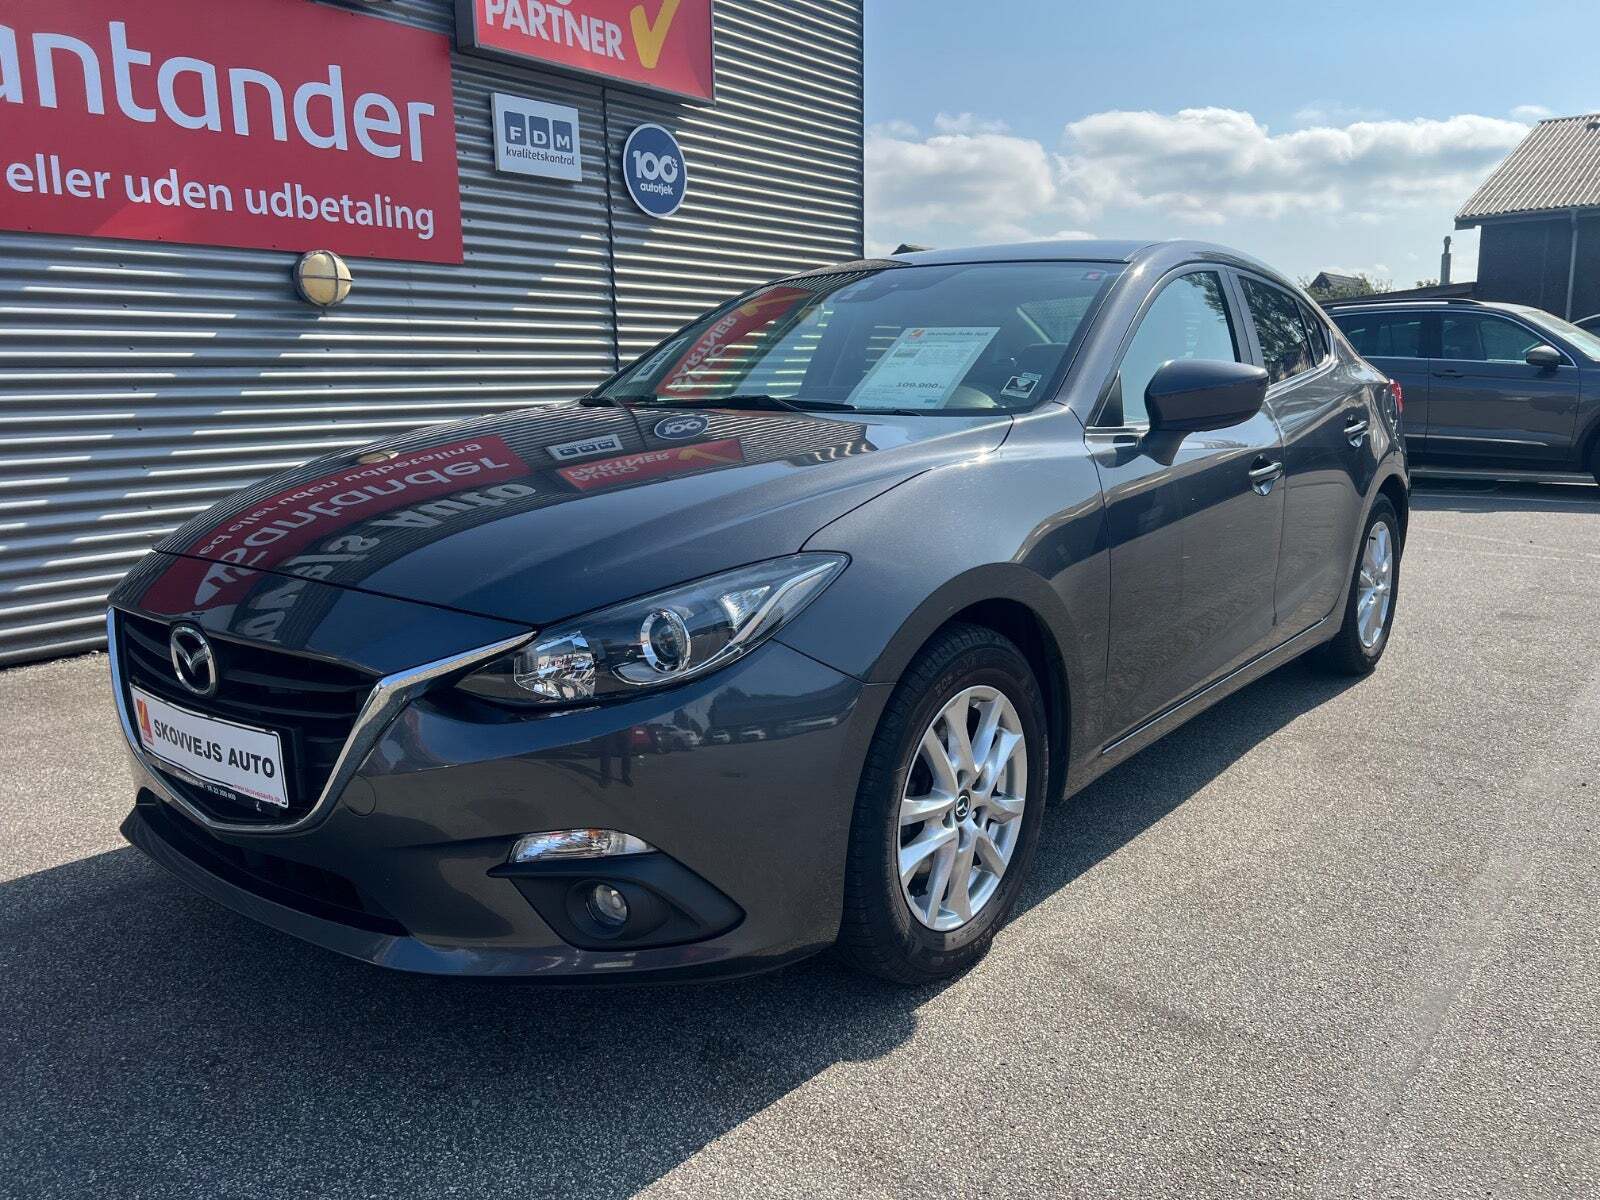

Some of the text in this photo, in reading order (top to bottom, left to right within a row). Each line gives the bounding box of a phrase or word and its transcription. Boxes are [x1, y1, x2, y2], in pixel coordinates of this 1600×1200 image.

[484, 0, 625, 60] PARTNER
[506, 146, 575, 166] kvalitetskontrol
[6, 153, 434, 240] eller uden udbetaling
[640, 182, 674, 196] autotjek
[153, 719, 275, 778] SKOVVEJS AUTO
